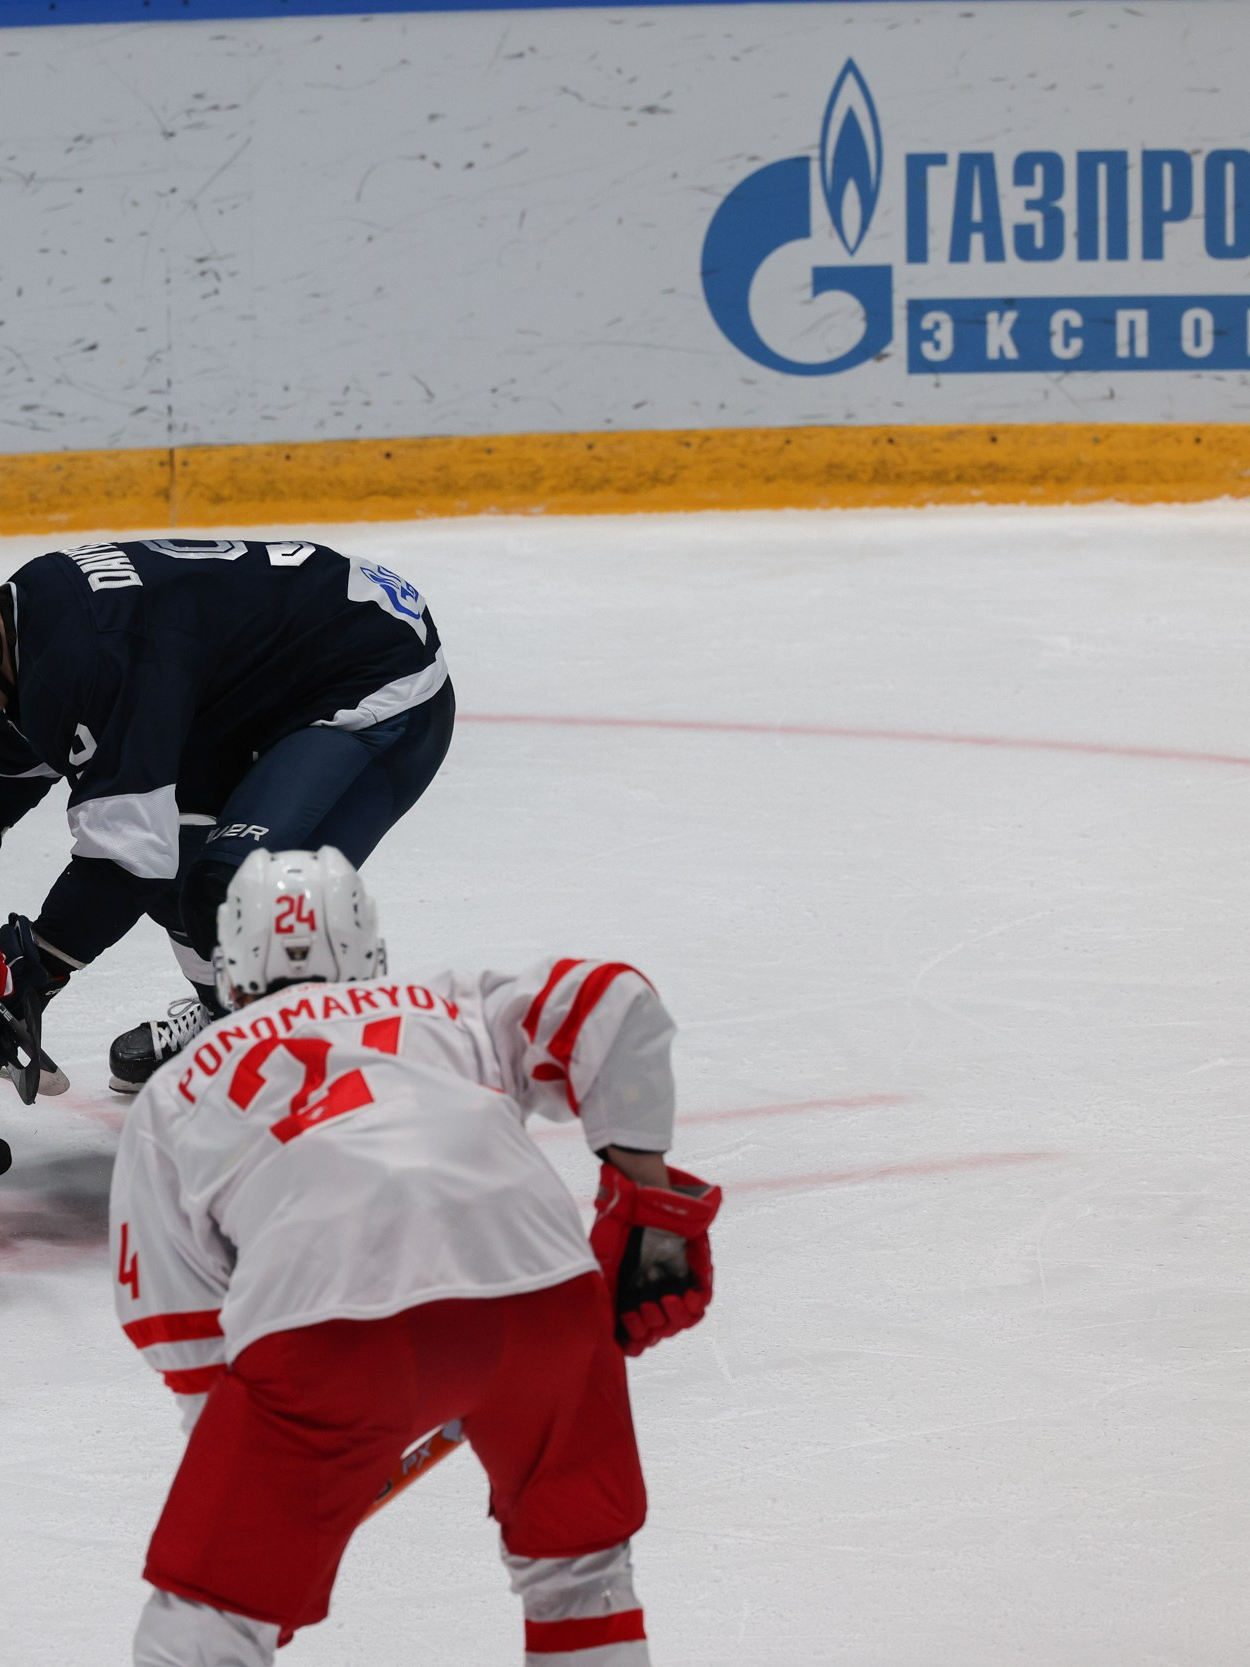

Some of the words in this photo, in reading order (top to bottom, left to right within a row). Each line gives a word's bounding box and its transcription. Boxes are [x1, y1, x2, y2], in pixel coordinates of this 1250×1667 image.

[905, 149, 1250, 264] ГАЗПРО
[920, 306, 1250, 362] ЭКСПО
[206, 823, 271, 845] UER
[275, 894, 317, 934] 24
